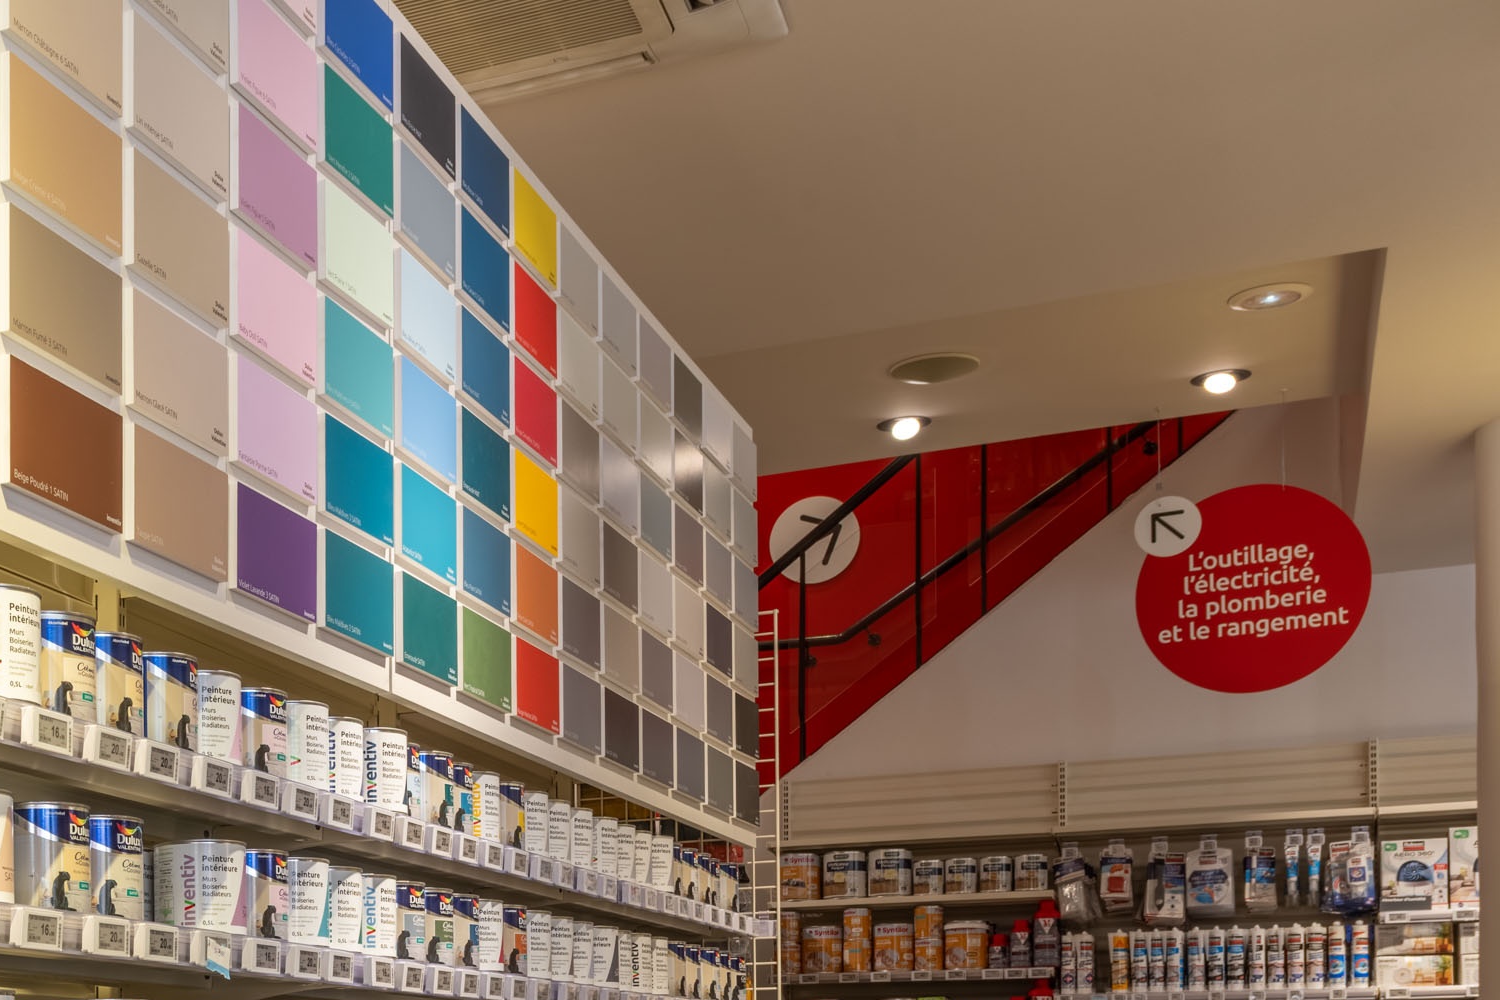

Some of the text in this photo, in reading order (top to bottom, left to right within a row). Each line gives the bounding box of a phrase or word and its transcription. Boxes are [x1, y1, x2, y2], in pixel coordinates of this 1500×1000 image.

[13, 468, 30, 485] Beige
[30, 473, 49, 493] Poudré
[53, 486, 69, 503] SATIN
[1188, 543, 1315, 572] L'outillage,
[1183, 561, 1321, 595] l'électricité,
[1178, 586, 1327, 620] la plomberie
[1158, 606, 1350, 644] et le rangement
